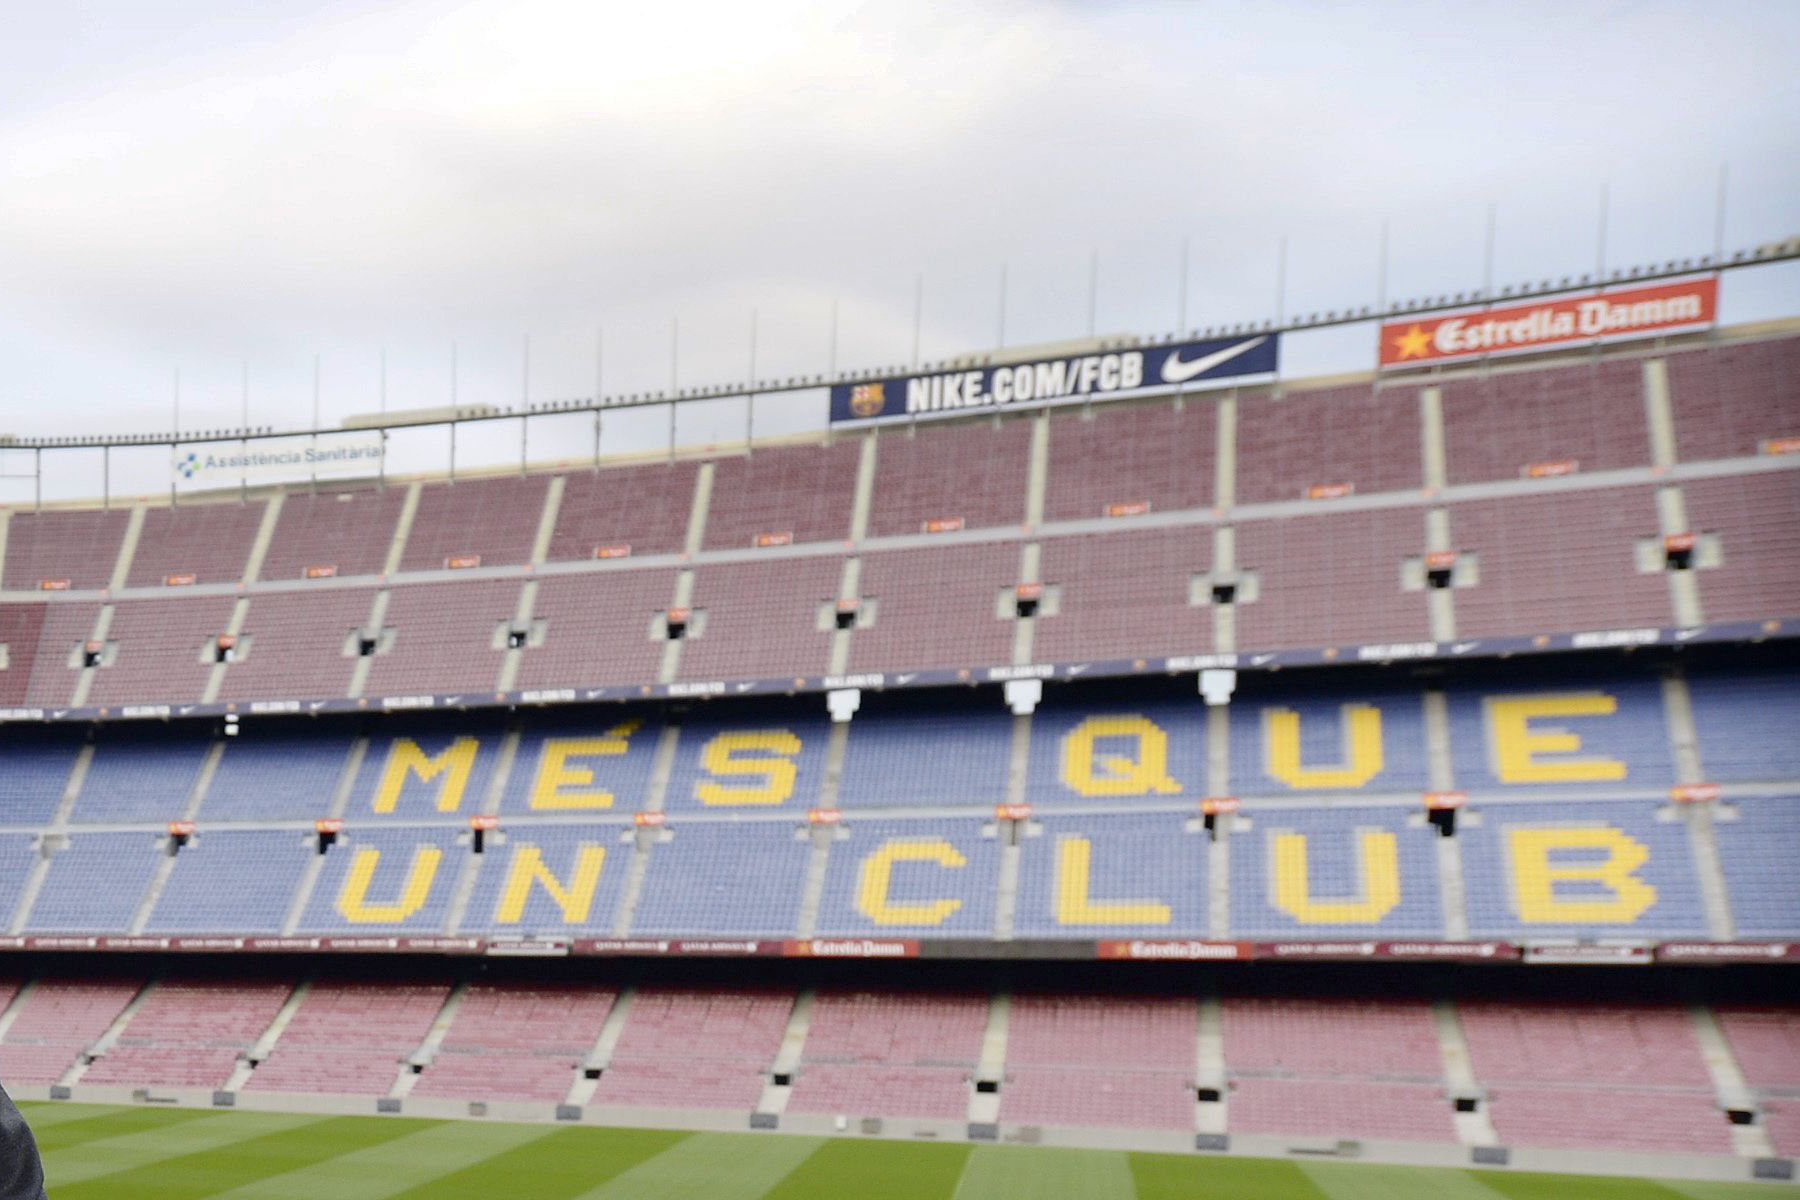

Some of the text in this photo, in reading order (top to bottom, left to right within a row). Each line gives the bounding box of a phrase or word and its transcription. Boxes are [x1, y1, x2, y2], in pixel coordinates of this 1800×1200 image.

[1434, 294, 1702, 354] Estrella Damm
[906, 351, 1144, 413] NIKE.COM/FCB
[370, 692, 1627, 813] MÉS QUE
[334, 824, 1658, 926] UN CLUB
